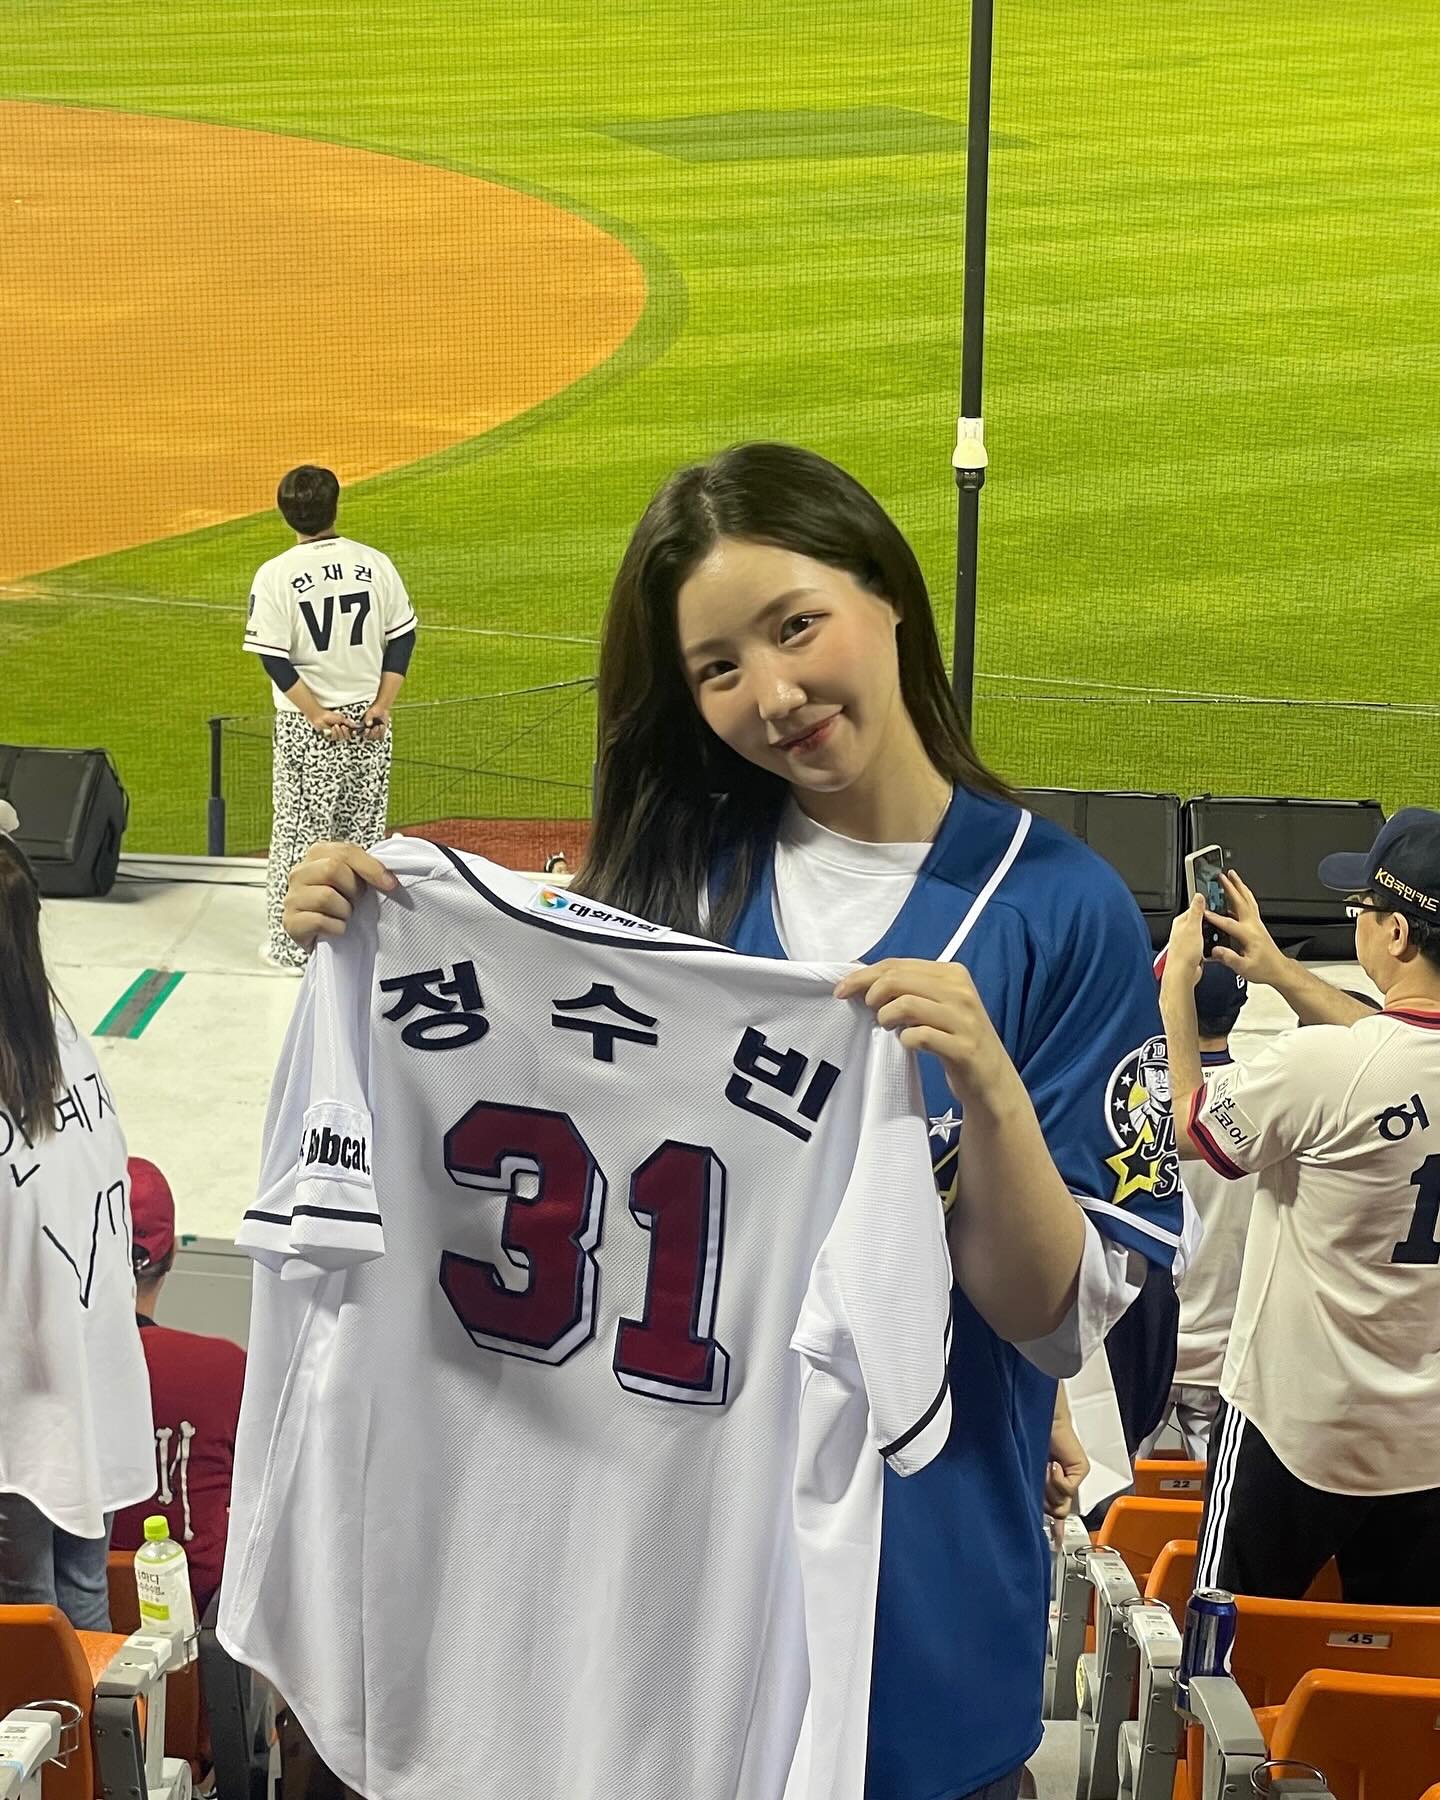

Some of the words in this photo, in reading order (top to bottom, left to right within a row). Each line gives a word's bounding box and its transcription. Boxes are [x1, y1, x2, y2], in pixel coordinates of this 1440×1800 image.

[298, 591, 371, 652] V7
[1374, 867, 1440, 912] KB국민카드
[438, 1099, 731, 1406] 31
[1172, 1480, 1190, 1488] 22
[1347, 1633, 1374, 1644] 45
